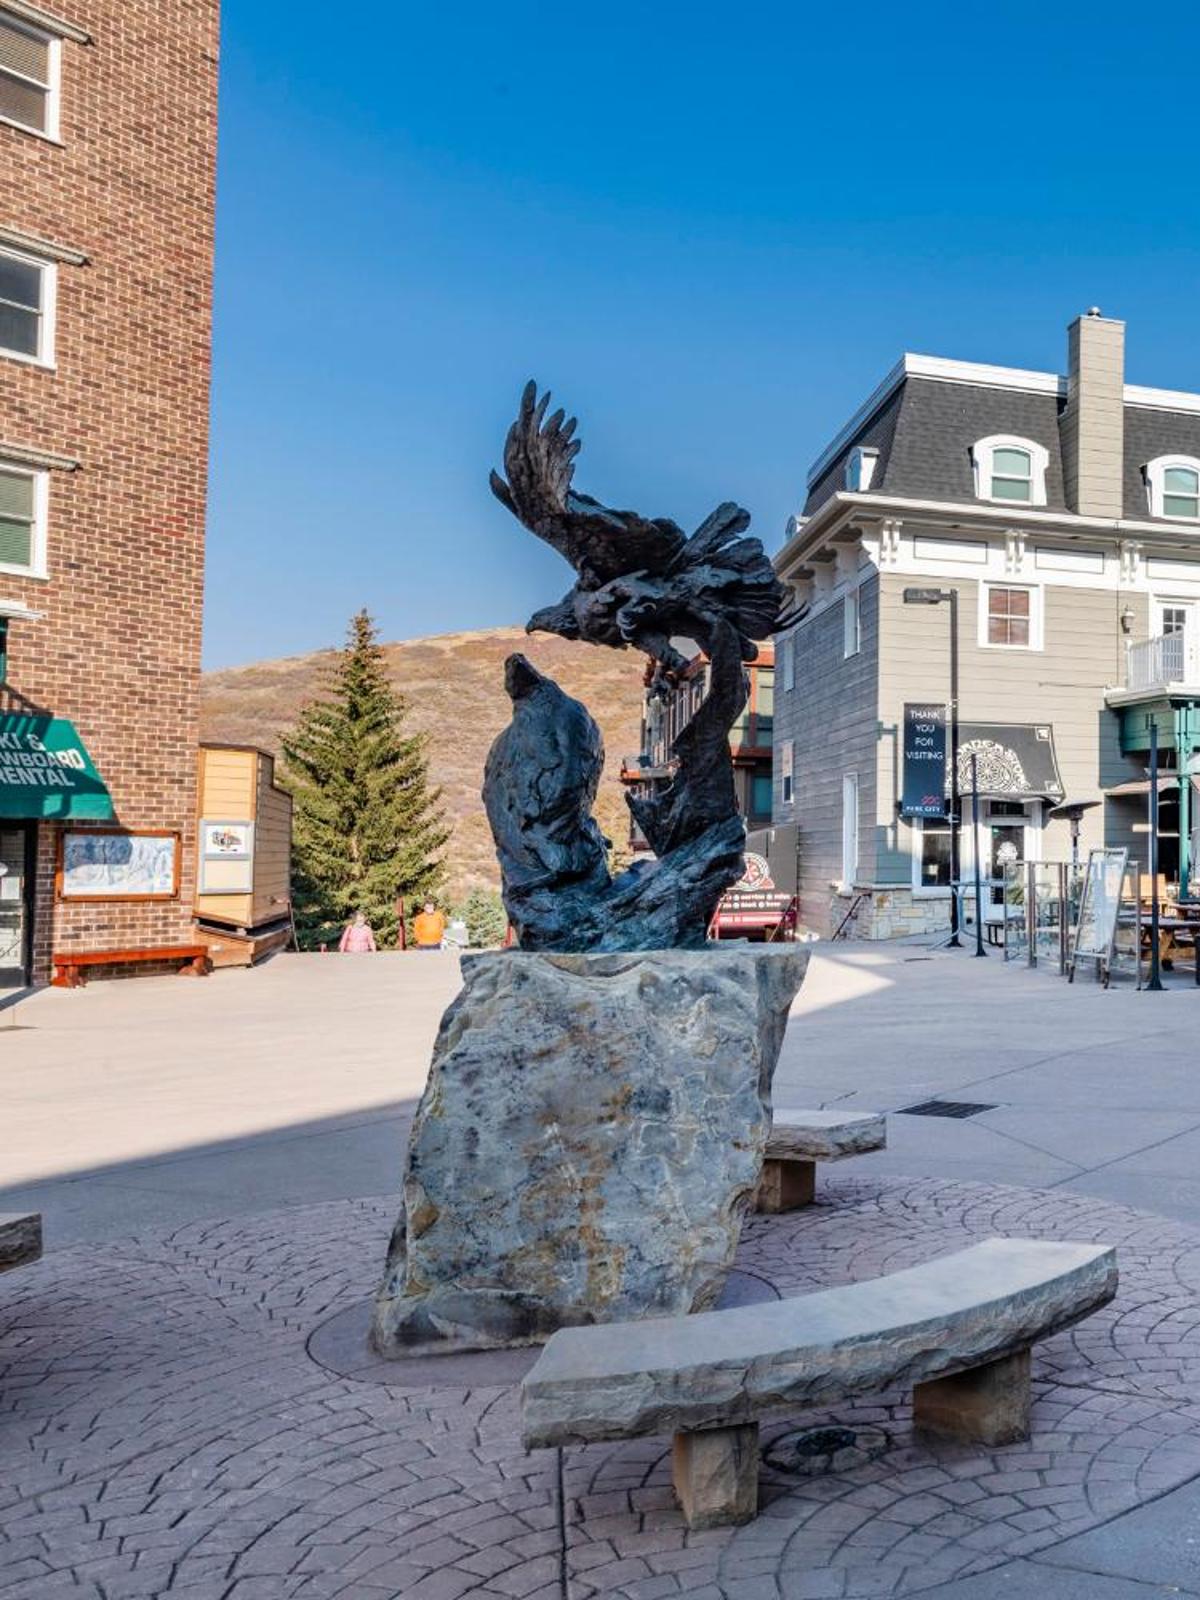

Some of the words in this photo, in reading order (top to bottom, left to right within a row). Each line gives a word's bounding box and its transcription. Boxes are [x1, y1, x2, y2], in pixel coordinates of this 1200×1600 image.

[910, 710, 940, 720] THANK
[915, 724, 935, 733] YOU
[0, 732, 23, 750] KI
[26, 733, 47, 751] &
[915, 737, 934, 747] FOR
[0, 748, 86, 769] WBOARD
[906, 751, 943, 760] VISITING
